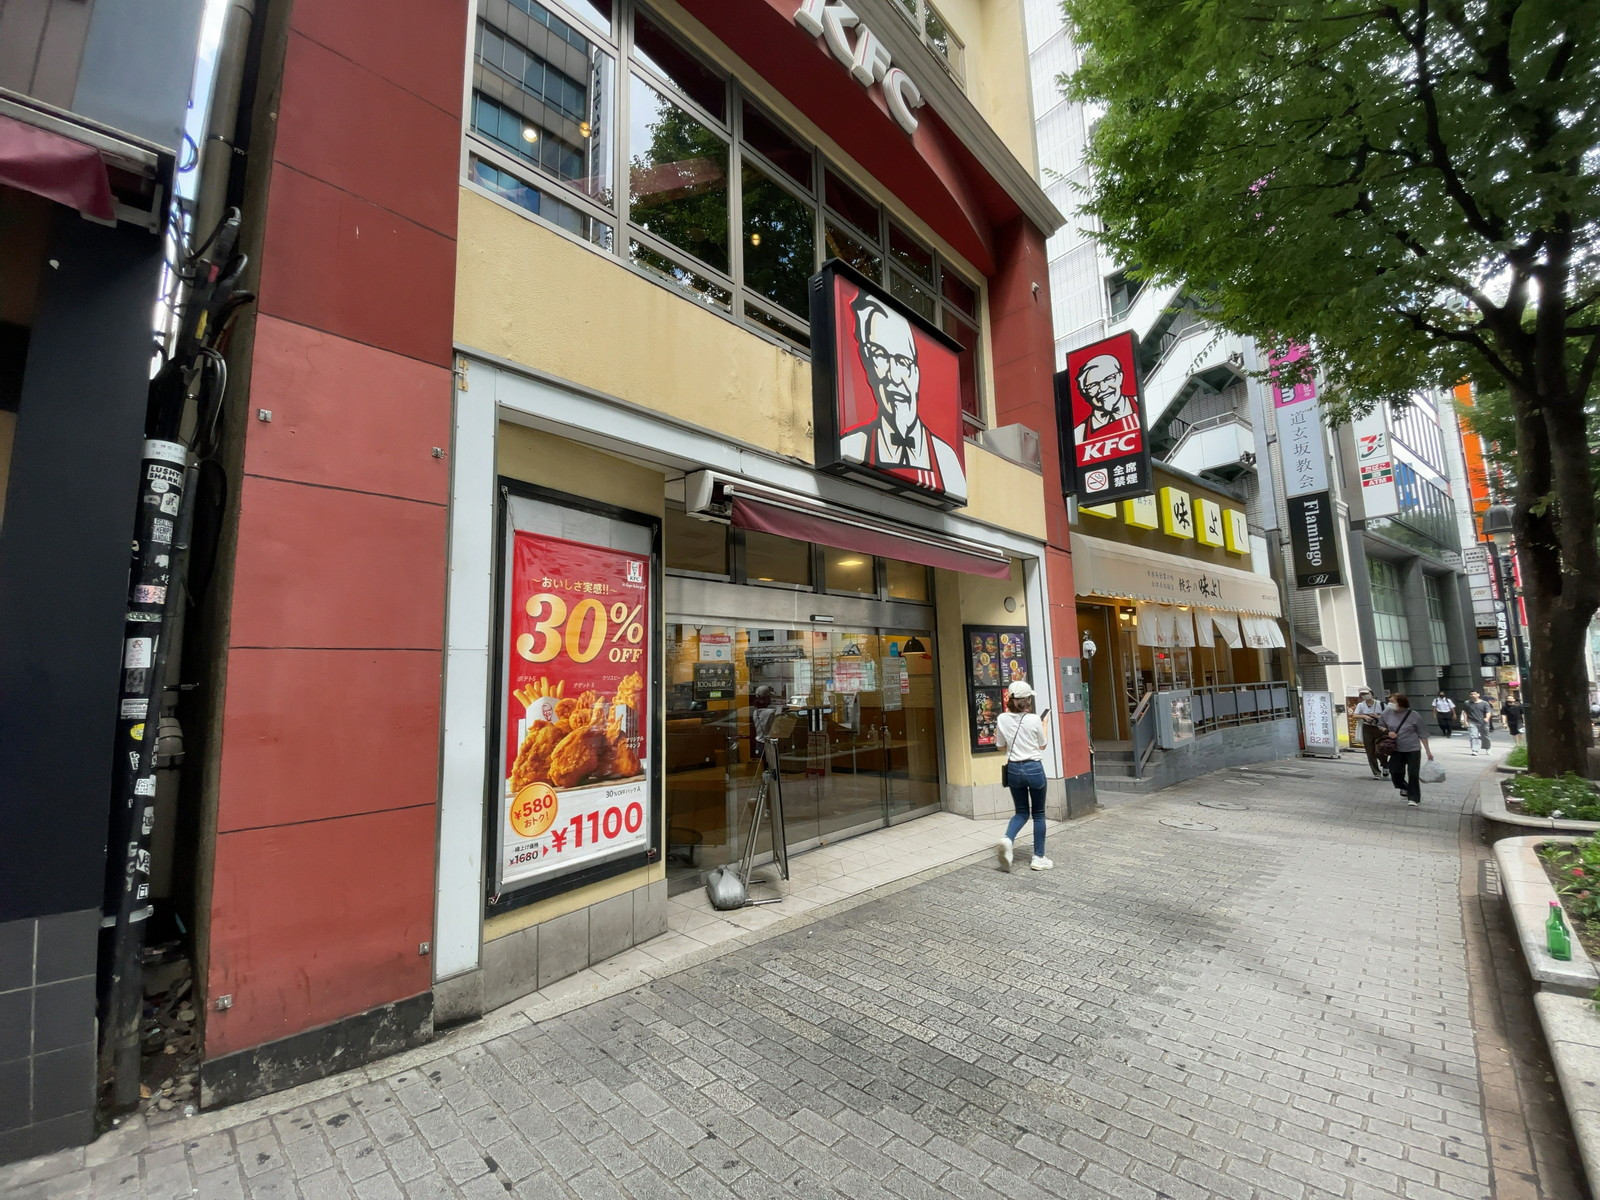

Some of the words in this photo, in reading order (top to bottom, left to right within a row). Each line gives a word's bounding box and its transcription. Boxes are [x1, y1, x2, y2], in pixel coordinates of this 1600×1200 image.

[794, 0, 925, 134] KFC
[1082, 433, 1136, 462] KFC
[1290, 409, 1315, 489] 道玄坂教会
[1113, 462, 1137, 476] 全席
[1113, 473, 1139, 487] 禁煙
[1368, 477, 1387, 486] ATM
[1303, 499, 1322, 567] Flamingo
[516, 593, 644, 663] 30%
[608, 647, 643, 663] OFF
[1309, 736, 1330, 744] 82席
[514, 794, 553, 821] ¥580
[551, 801, 643, 852] ¥1100
[509, 851, 538, 866] ¥1680
